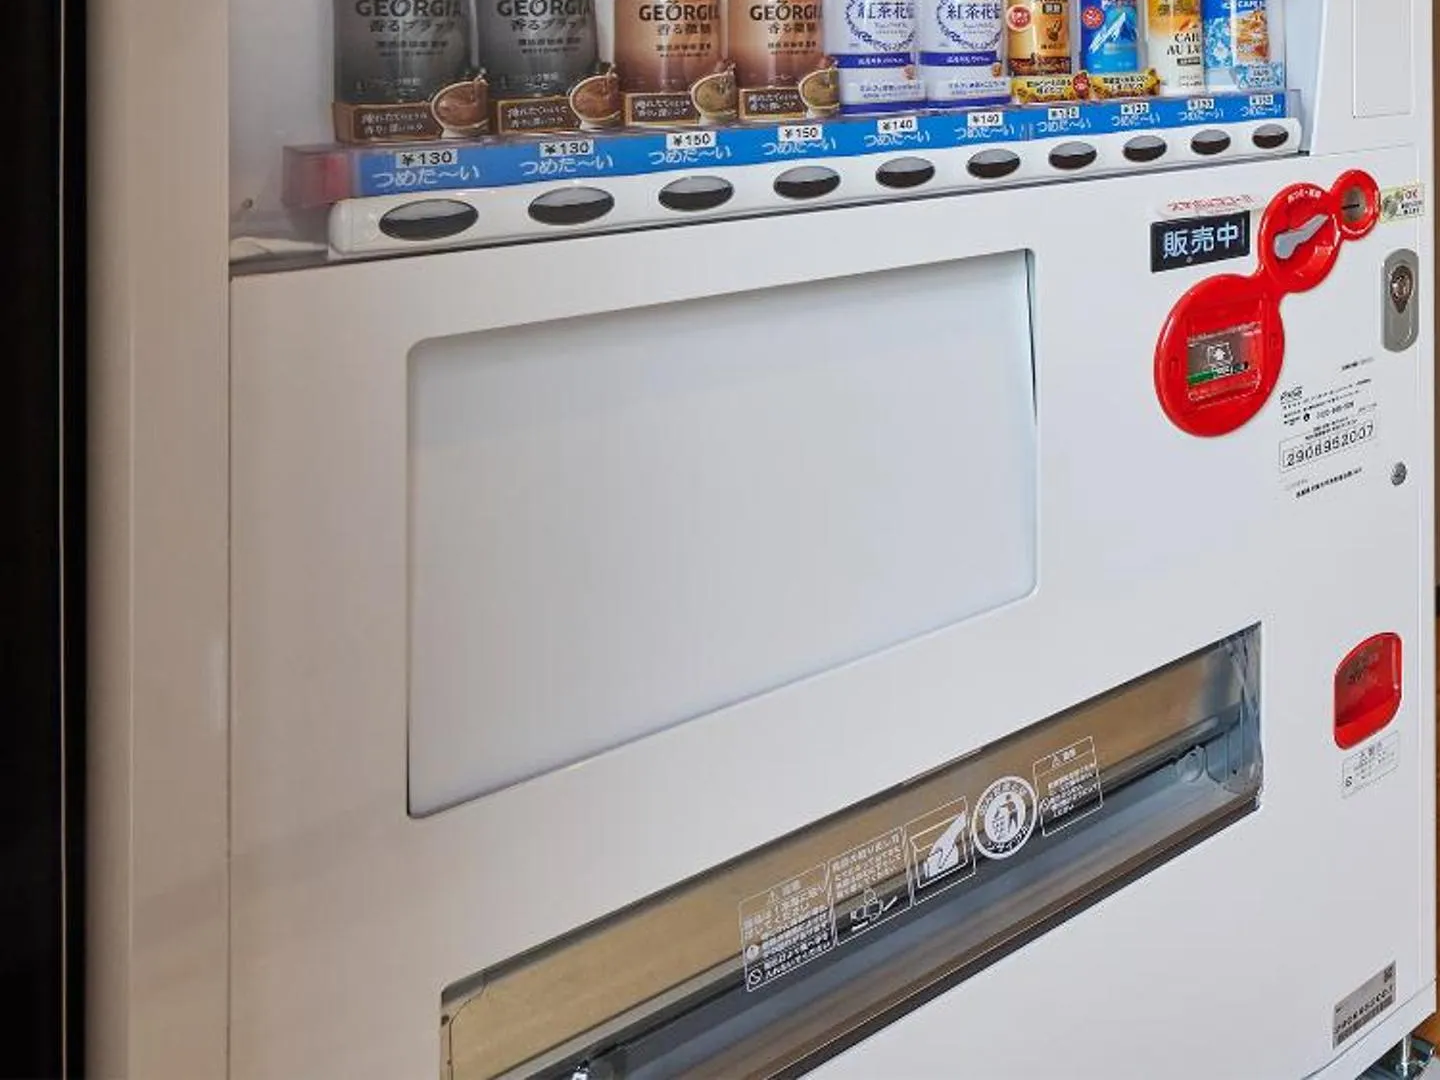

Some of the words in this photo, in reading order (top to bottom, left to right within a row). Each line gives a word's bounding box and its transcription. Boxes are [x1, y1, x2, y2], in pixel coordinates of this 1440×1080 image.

[544, 142, 589, 156] ¥130
[401, 151, 453, 166] ¥130
[1163, 221, 1240, 259] 販売中
